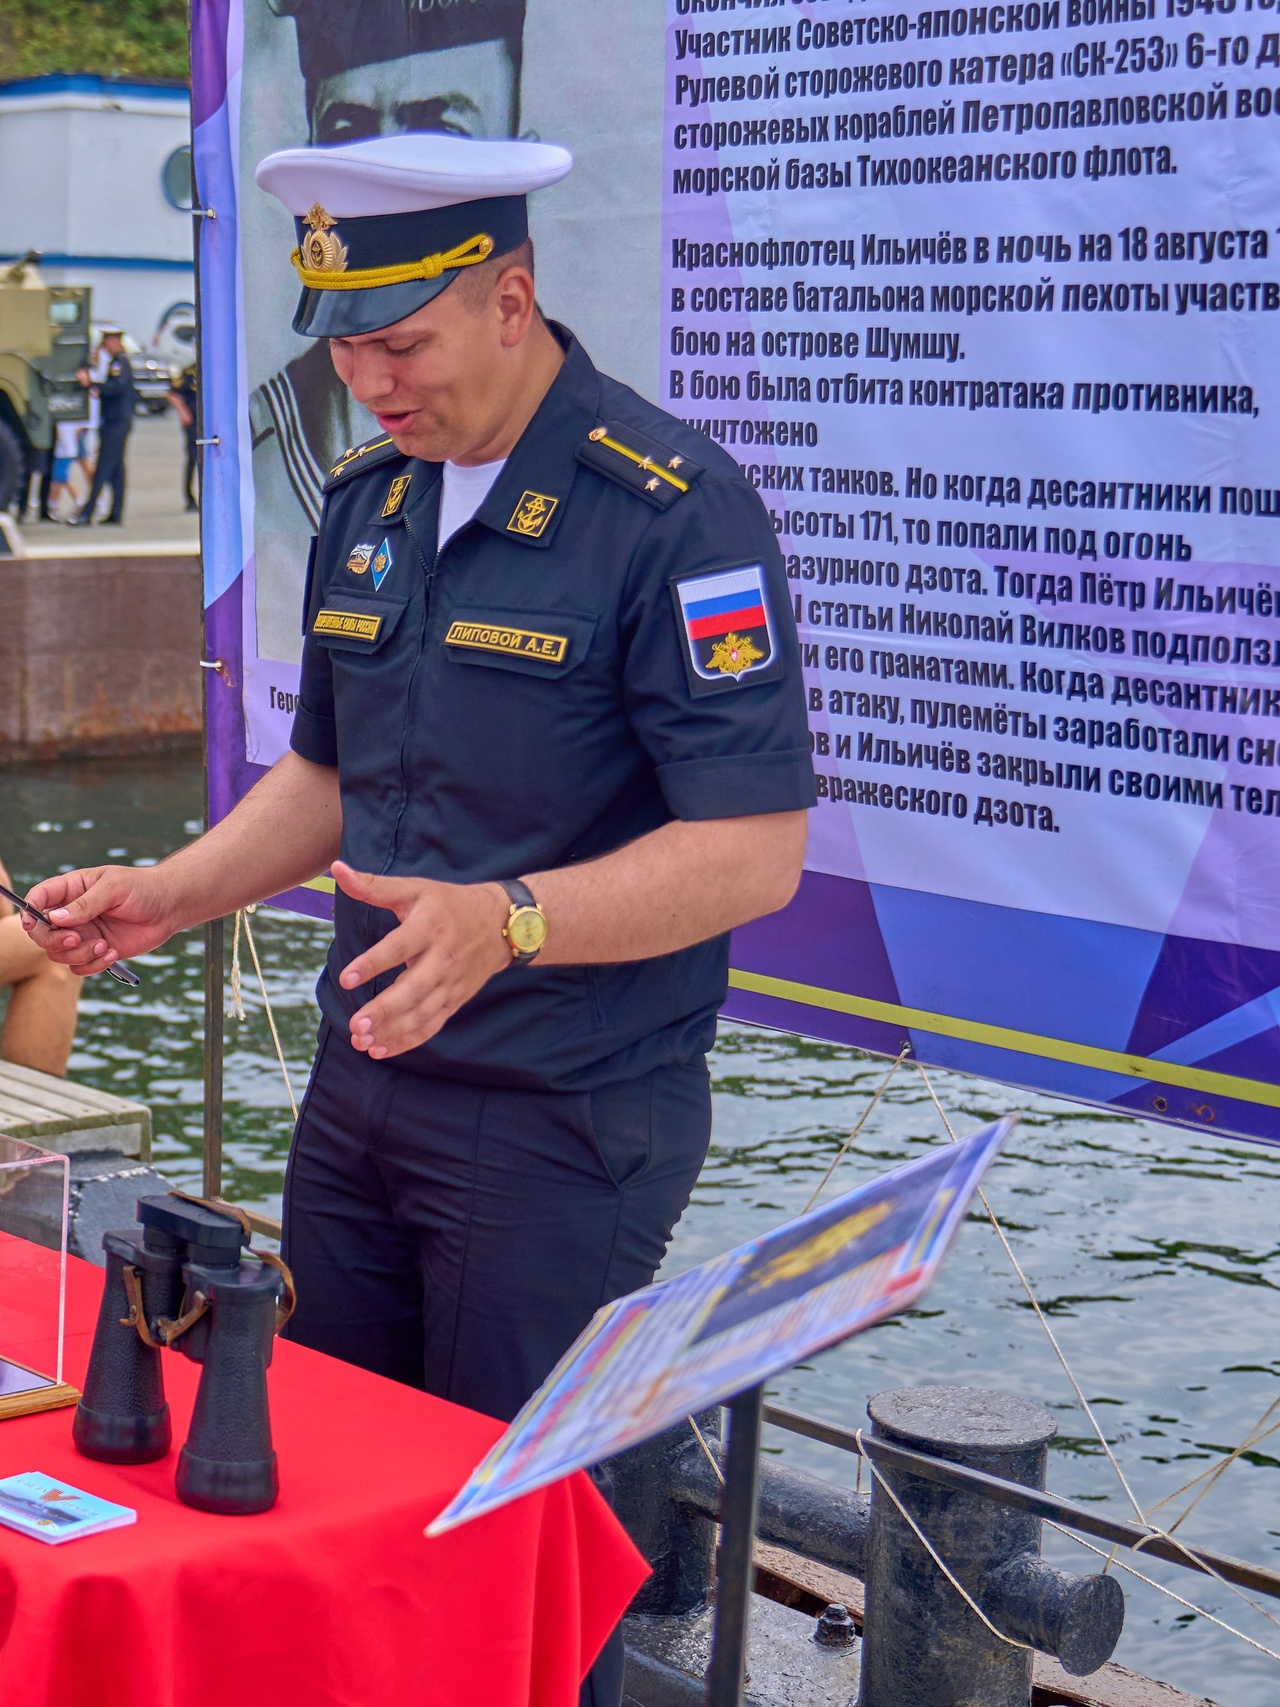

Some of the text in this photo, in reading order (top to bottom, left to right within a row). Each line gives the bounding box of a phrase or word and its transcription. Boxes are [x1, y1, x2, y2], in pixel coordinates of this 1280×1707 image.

[674, 25, 792, 60] Участник
[797, 0, 1060, 51] Советско-японской
[675, 65, 780, 108] Рулевой
[785, 59, 943, 98] сторожевого
[950, 51, 1054, 85] катера
[1061, 35, 1178, 78] «СК-253»
[1187, 32, 1250, 69] 6-го
[674, 115, 829, 151] сторожевых
[834, 99, 956, 143] кораблей
[963, 81, 1228, 135] Петропавловской
[673, 144, 1178, 196] морской базы Тихоокеанского флота.
[672, 226, 1269, 272] Краснофлотец Ильичёв в ночь на 18 августа
[671, 276, 1280, 316] в составе батальона морской пехоты участв
[671, 325, 965, 363] бою на острове Шумшу.
[670, 369, 1259, 418] В бою была отбита контратака противника,
[680, 418, 818, 448] ичтожено
[809, 467, 899, 498] танков.
[906, 467, 938, 499] Но
[944, 474, 1021, 508] когда
[1028, 478, 1212, 514] десантники
[1220, 486, 1280, 518] пош
[859, 510, 899, 546] 171,
[902, 518, 931, 545] то
[937, 520, 1037, 553] попали
[1044, 527, 1098, 562] под
[1105, 531, 1193, 562] огонь
[906, 564, 988, 596] дзота.
[994, 565, 1073, 606] Тогда
[1080, 571, 1146, 612] Пётр
[450, 625, 557, 656] ЛИПОВОЙ А.Е.
[809, 600, 893, 633] статьи
[900, 603, 1014, 644] Николай
[1020, 614, 1126, 654] Вилков
[825, 645, 864, 673] его
[870, 650, 1015, 691] гранатами.
[1021, 661, 1105, 703] Когда
[1112, 675, 1280, 717] десантник
[809, 687, 1280, 767] в атаку, пулемёты заработали сн
[836, 734, 852, 760] и
[858, 731, 971, 774] Ильичёв
[977, 751, 1101, 793] закрыли
[1109, 769, 1224, 810] своими
[815, 774, 1060, 833] вражеского дзота.
